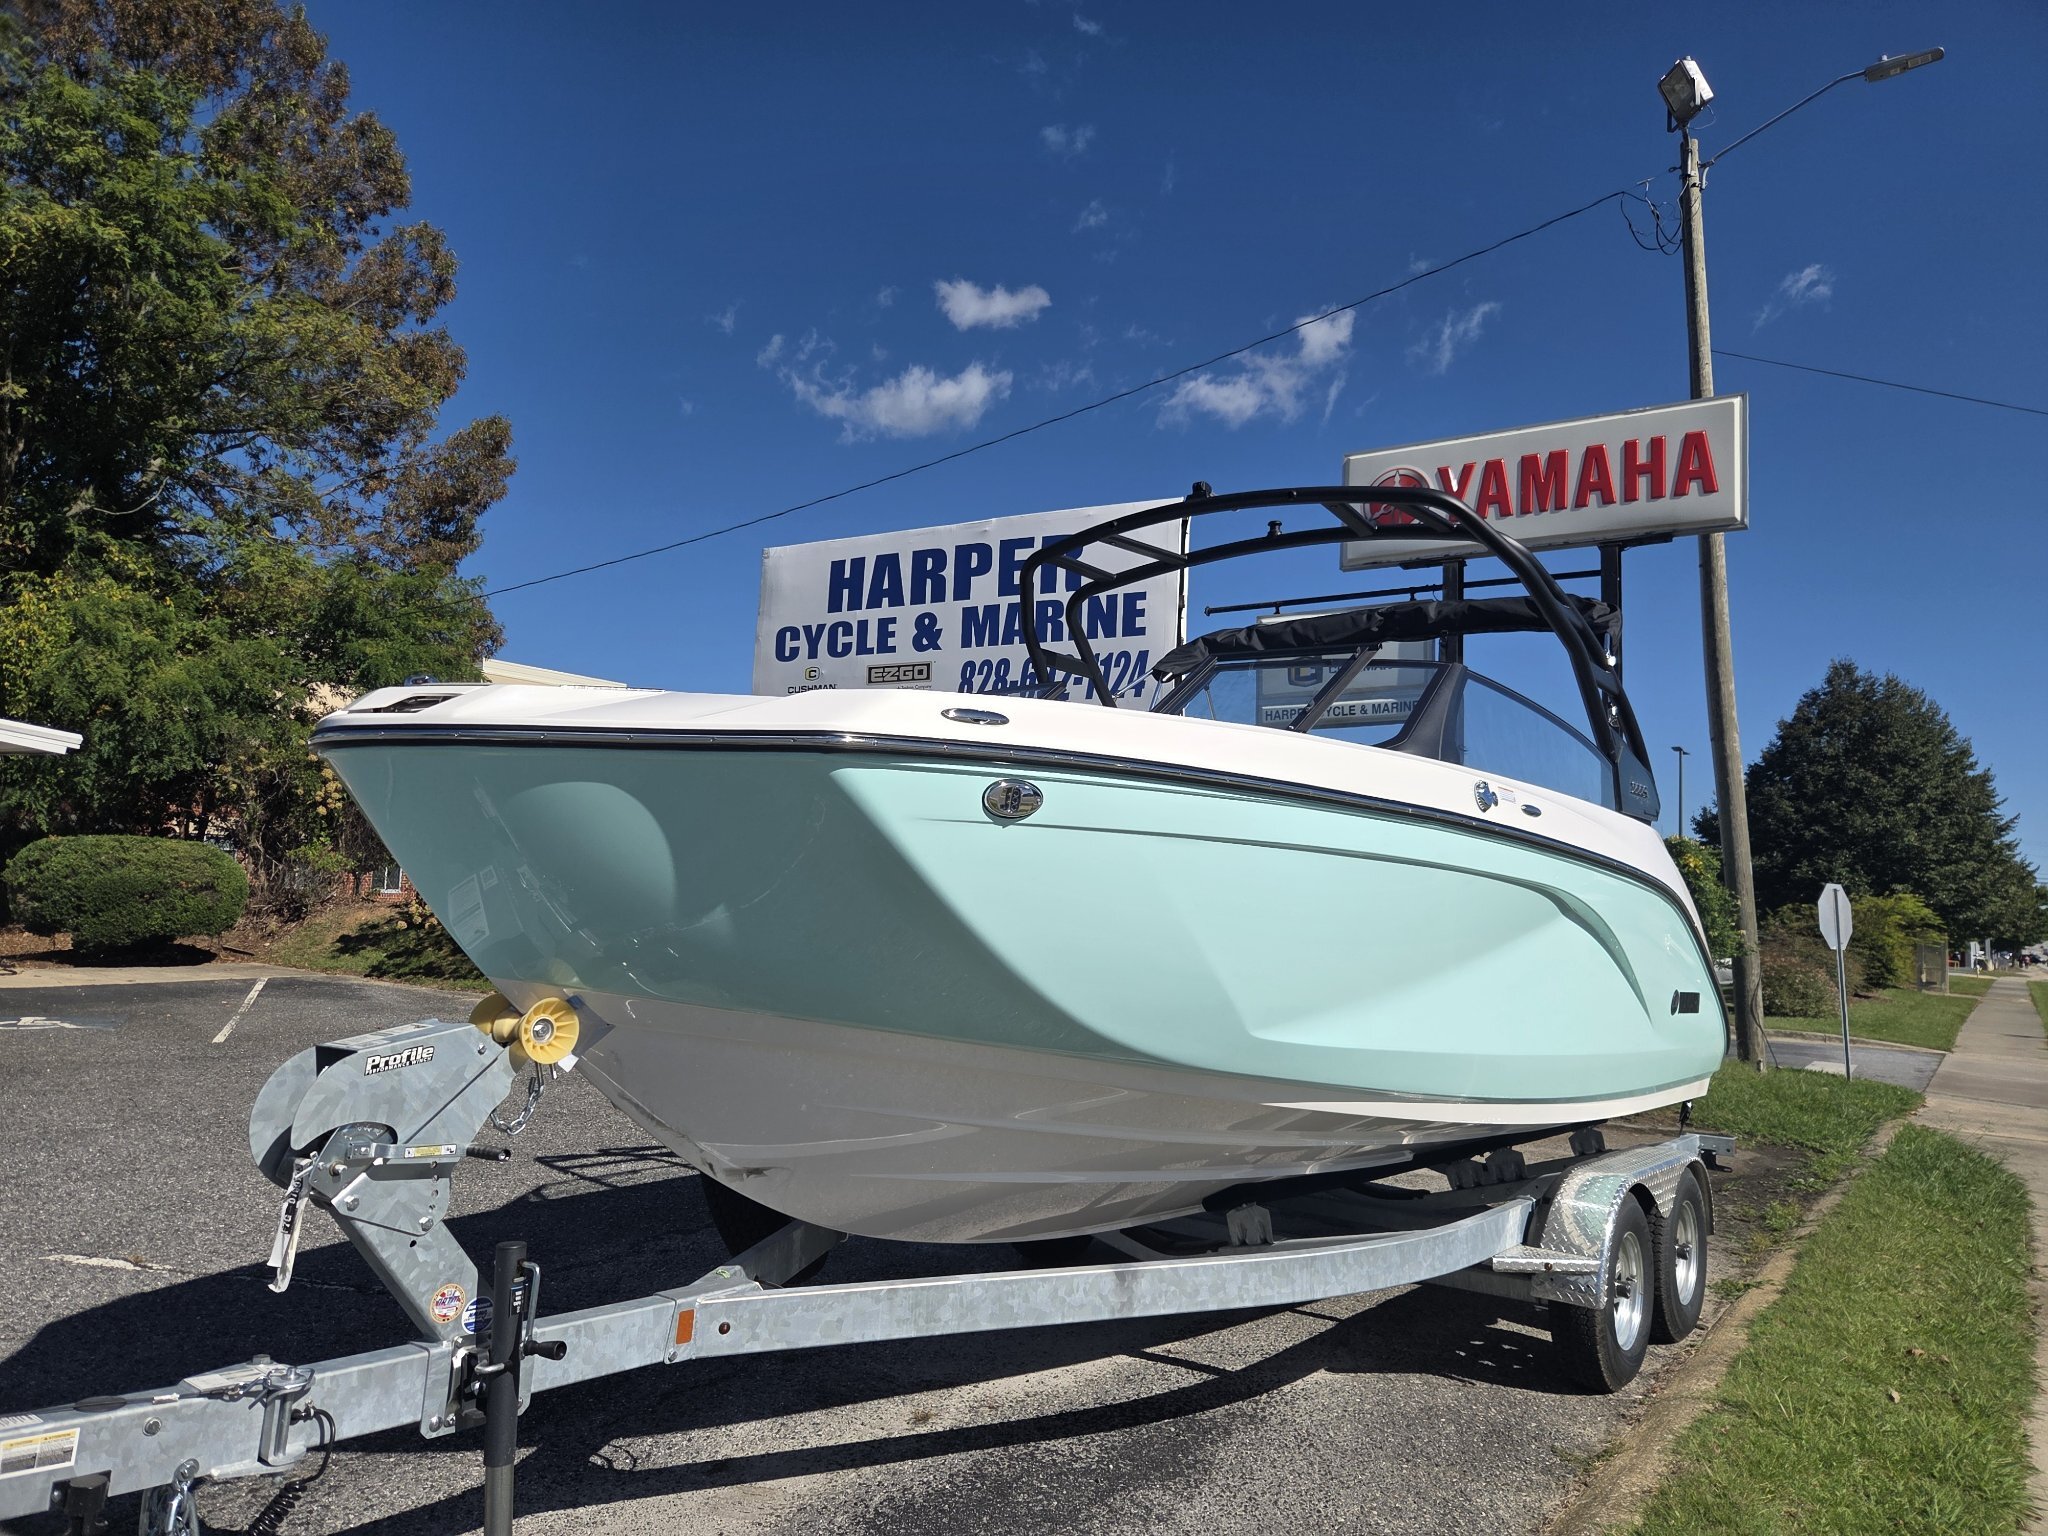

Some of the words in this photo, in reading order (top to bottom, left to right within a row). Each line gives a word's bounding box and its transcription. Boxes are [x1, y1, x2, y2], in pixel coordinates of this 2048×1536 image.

[1437, 430, 1720, 524] YAMAHA
[775, 616, 896, 662] CYCLE
[912, 611, 943, 652] &
[870, 665, 928, 682] EZGO
[958, 650, 1149, 700] 828-6-124
[1265, 708, 1305, 721] HARP
[1326, 705, 1356, 717] YCLE
[1360, 704, 1368, 714] &
[365, 1046, 434, 1071] Profile
